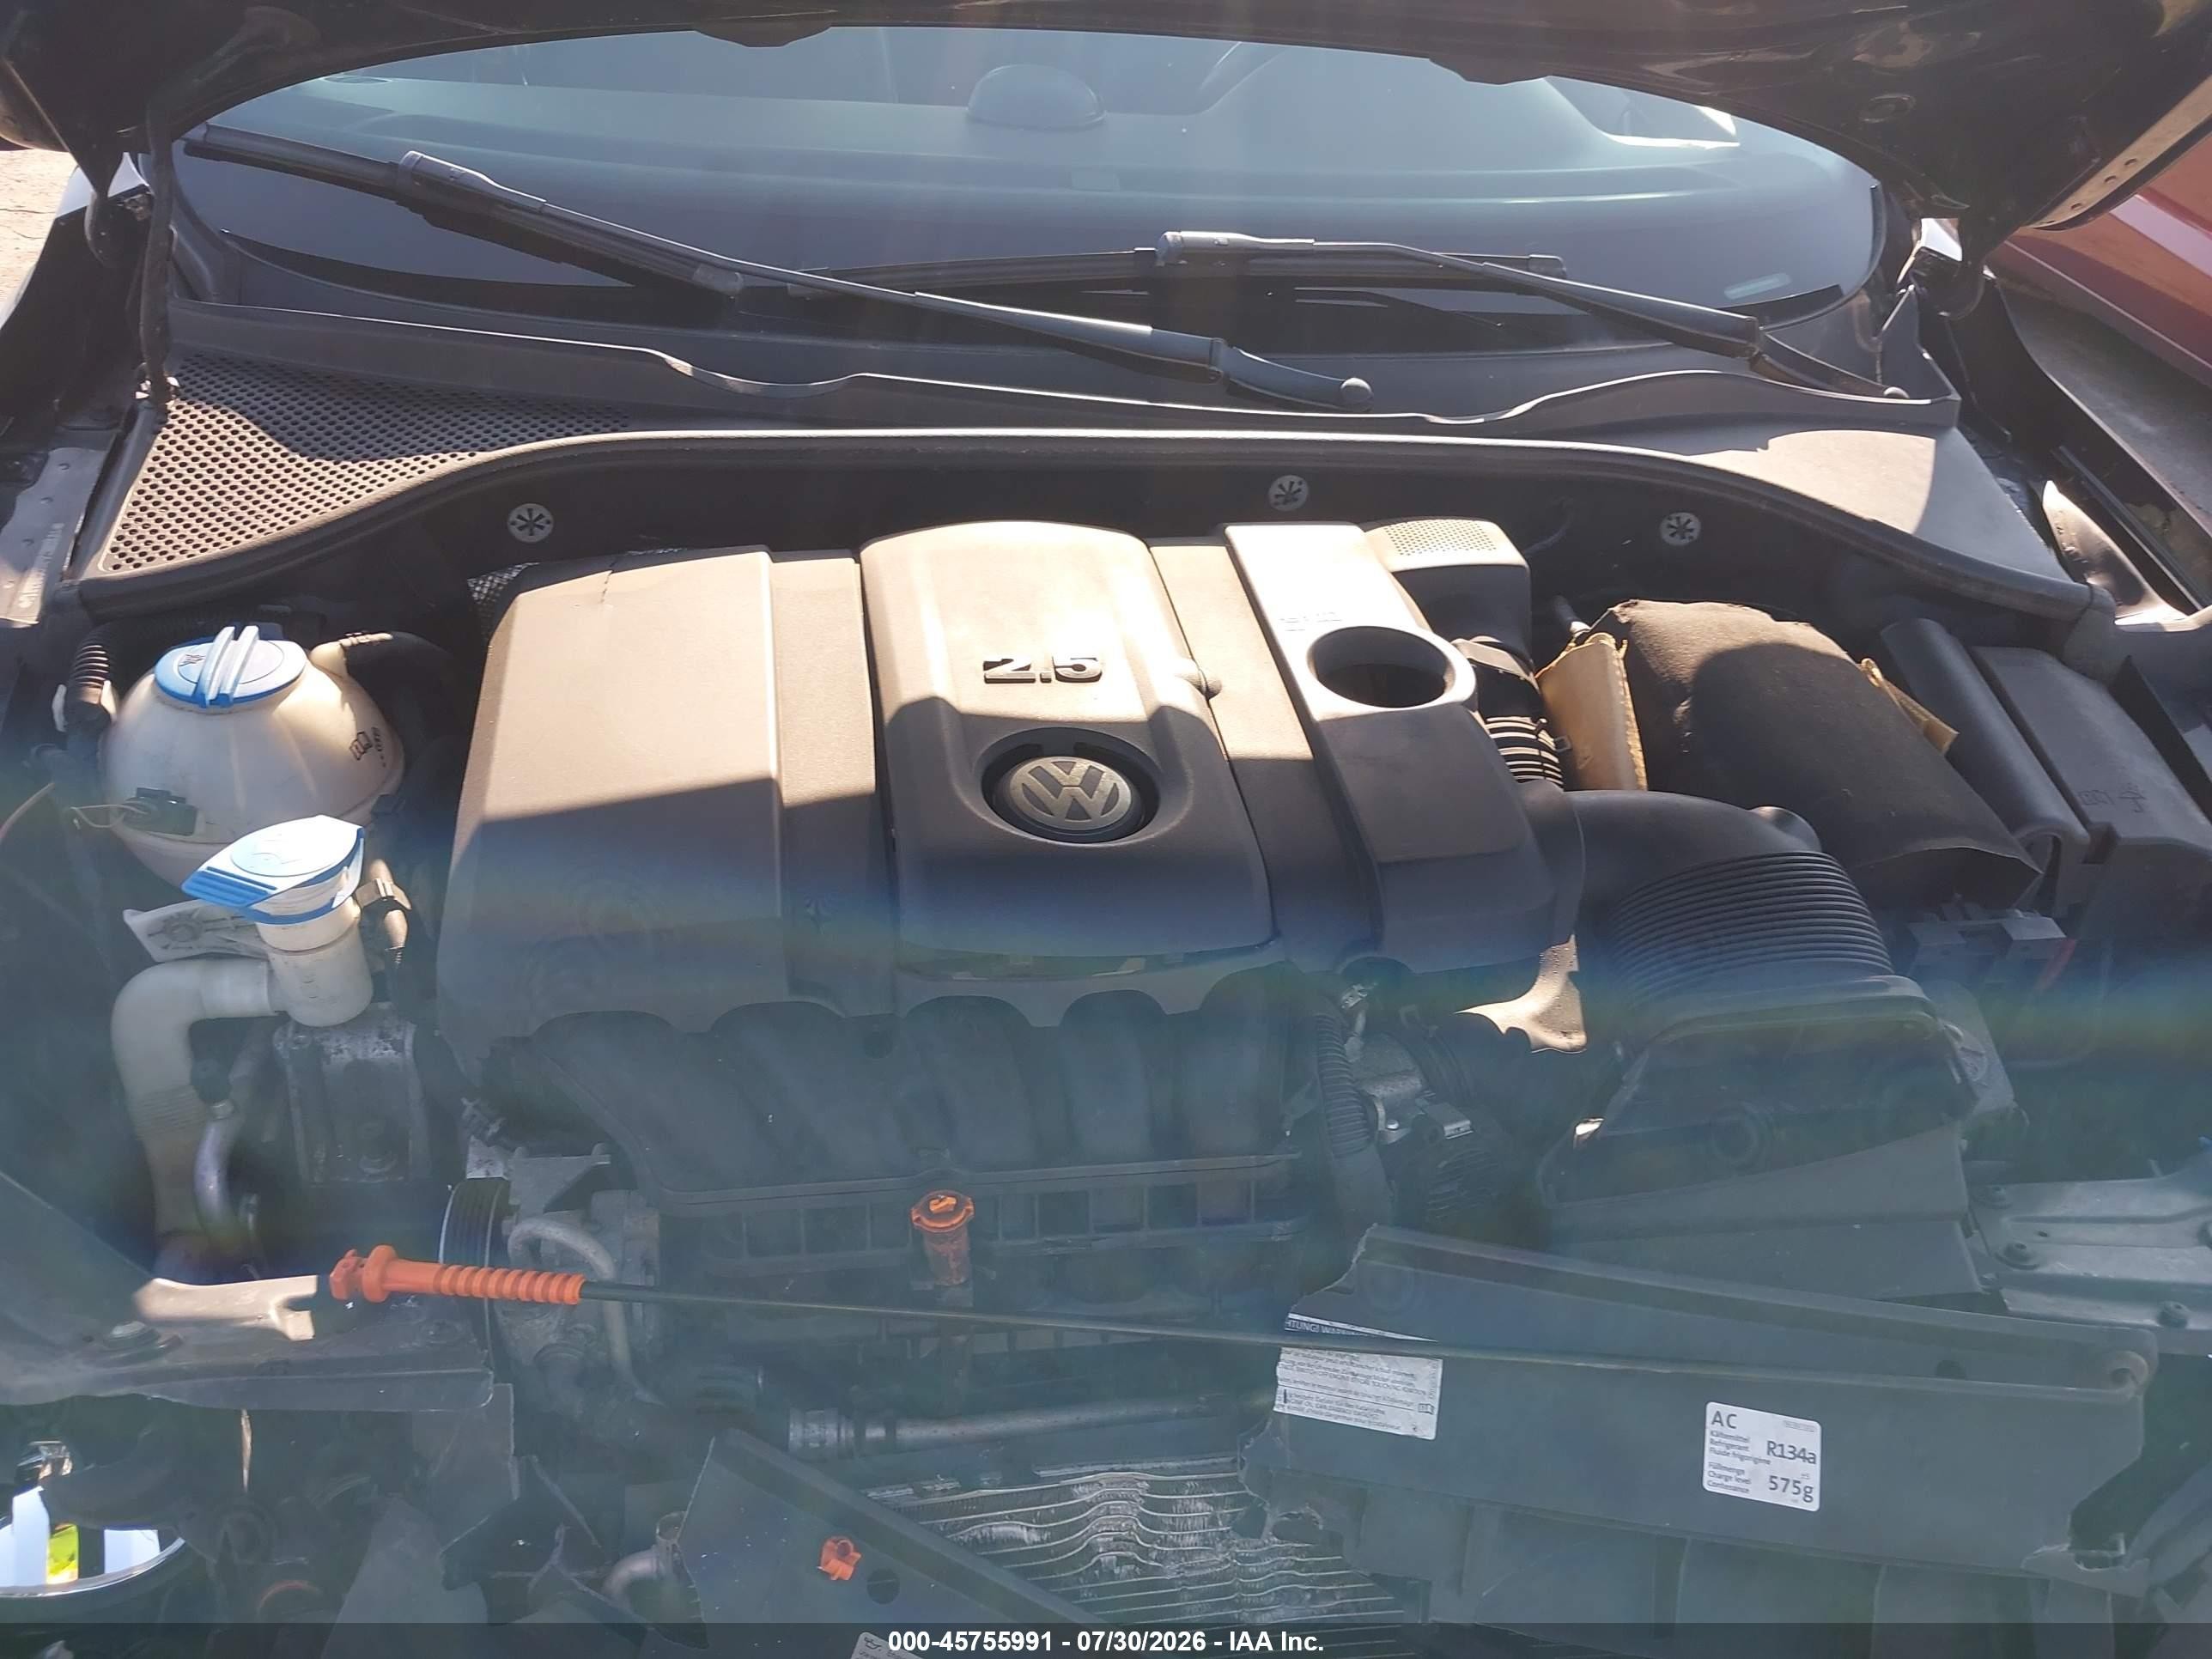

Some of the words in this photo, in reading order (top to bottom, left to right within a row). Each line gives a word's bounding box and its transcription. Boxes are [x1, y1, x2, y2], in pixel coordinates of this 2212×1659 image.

[982, 656, 1103, 684] 2.5
[1711, 1411, 1737, 1429] AC
[1766, 1440, 1817, 1465] R134a
[1769, 1475, 1814, 1503] 575g
